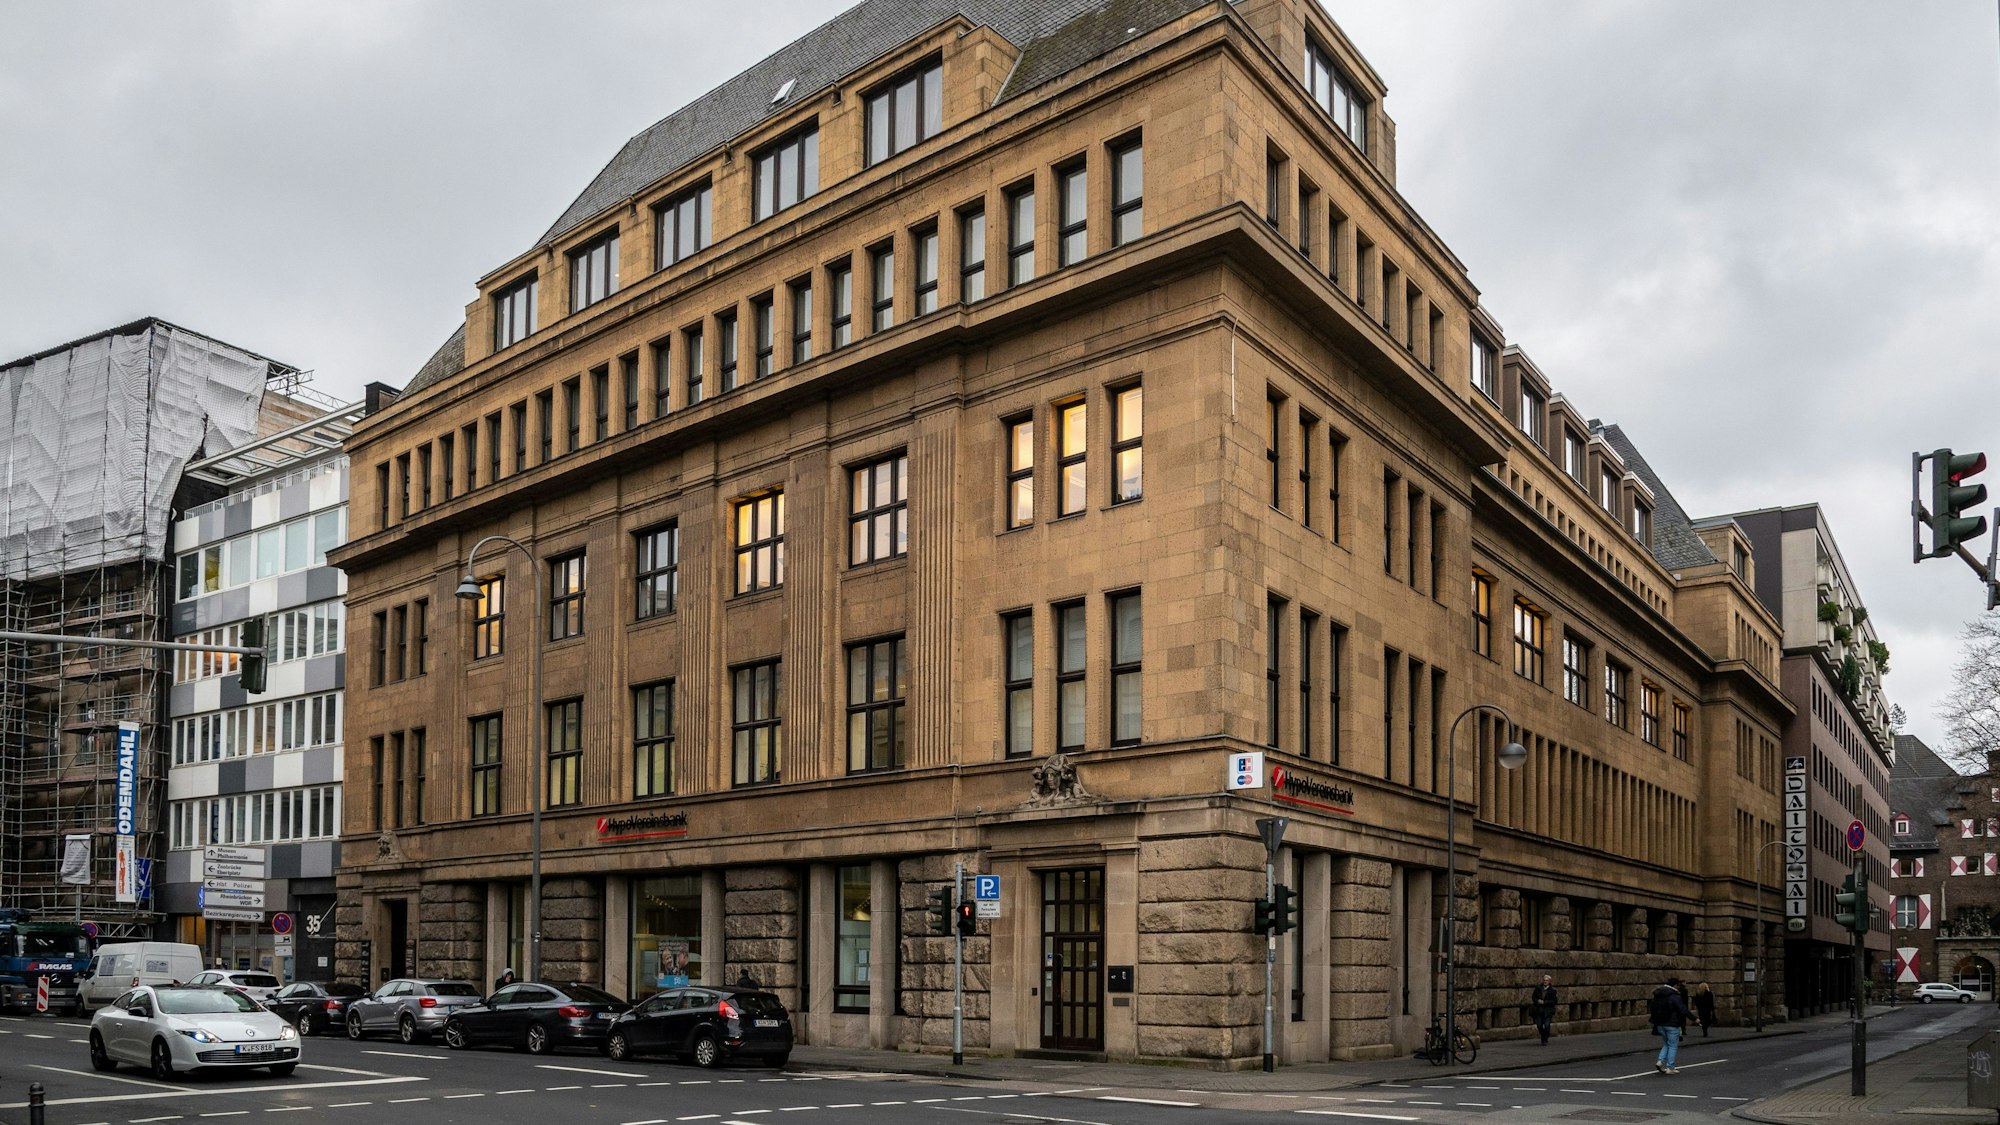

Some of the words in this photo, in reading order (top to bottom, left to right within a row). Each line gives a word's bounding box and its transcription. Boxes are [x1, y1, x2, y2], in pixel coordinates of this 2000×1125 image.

[119, 731, 135, 834] ODENDAHL
[1284, 770, 1354, 805] HypoVereinsbank
[608, 810, 687, 835] HypoVereinsbank
[1788, 776, 1804, 914] DAITOAI
[981, 878, 994, 896] P
[206, 910, 252, 919] Bezirksregierung
[306, 914, 320, 932] 35
